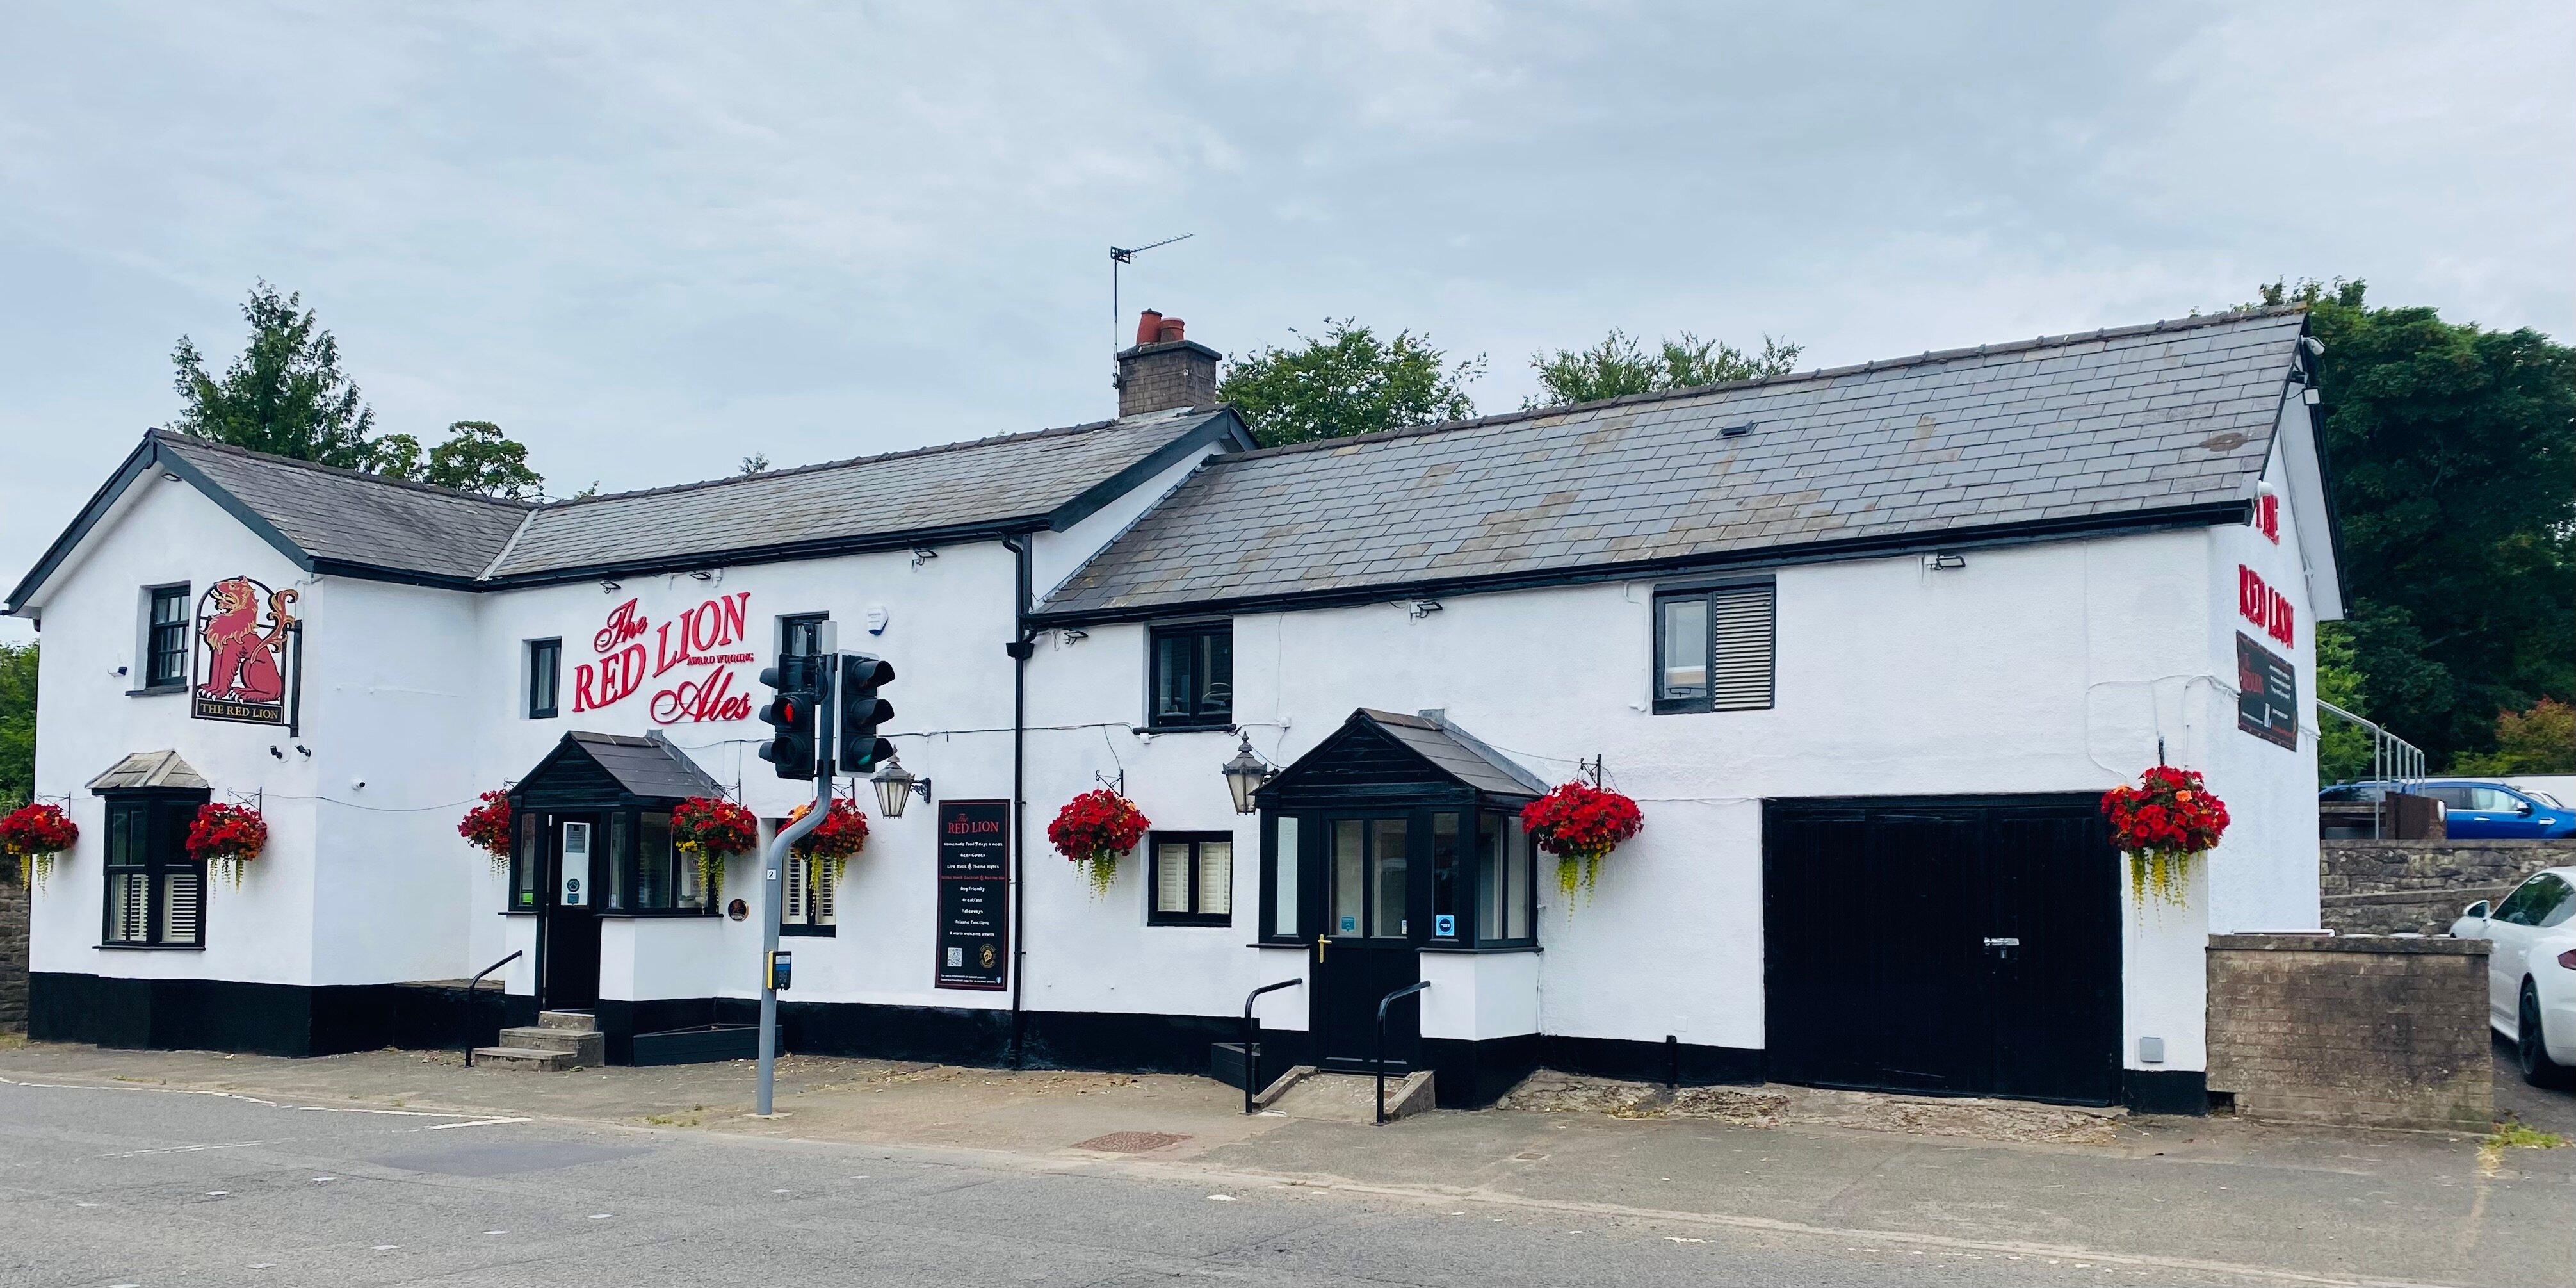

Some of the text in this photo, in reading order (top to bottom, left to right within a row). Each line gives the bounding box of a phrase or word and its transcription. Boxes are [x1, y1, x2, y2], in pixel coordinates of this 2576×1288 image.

[594, 598, 647, 653] The
[572, 592, 750, 712] RED LION
[687, 653, 754, 665] AWARD WINNING
[200, 703, 278, 719] THE RED LION
[650, 664, 752, 724] Ales
[948, 821, 999, 834] RED LION
